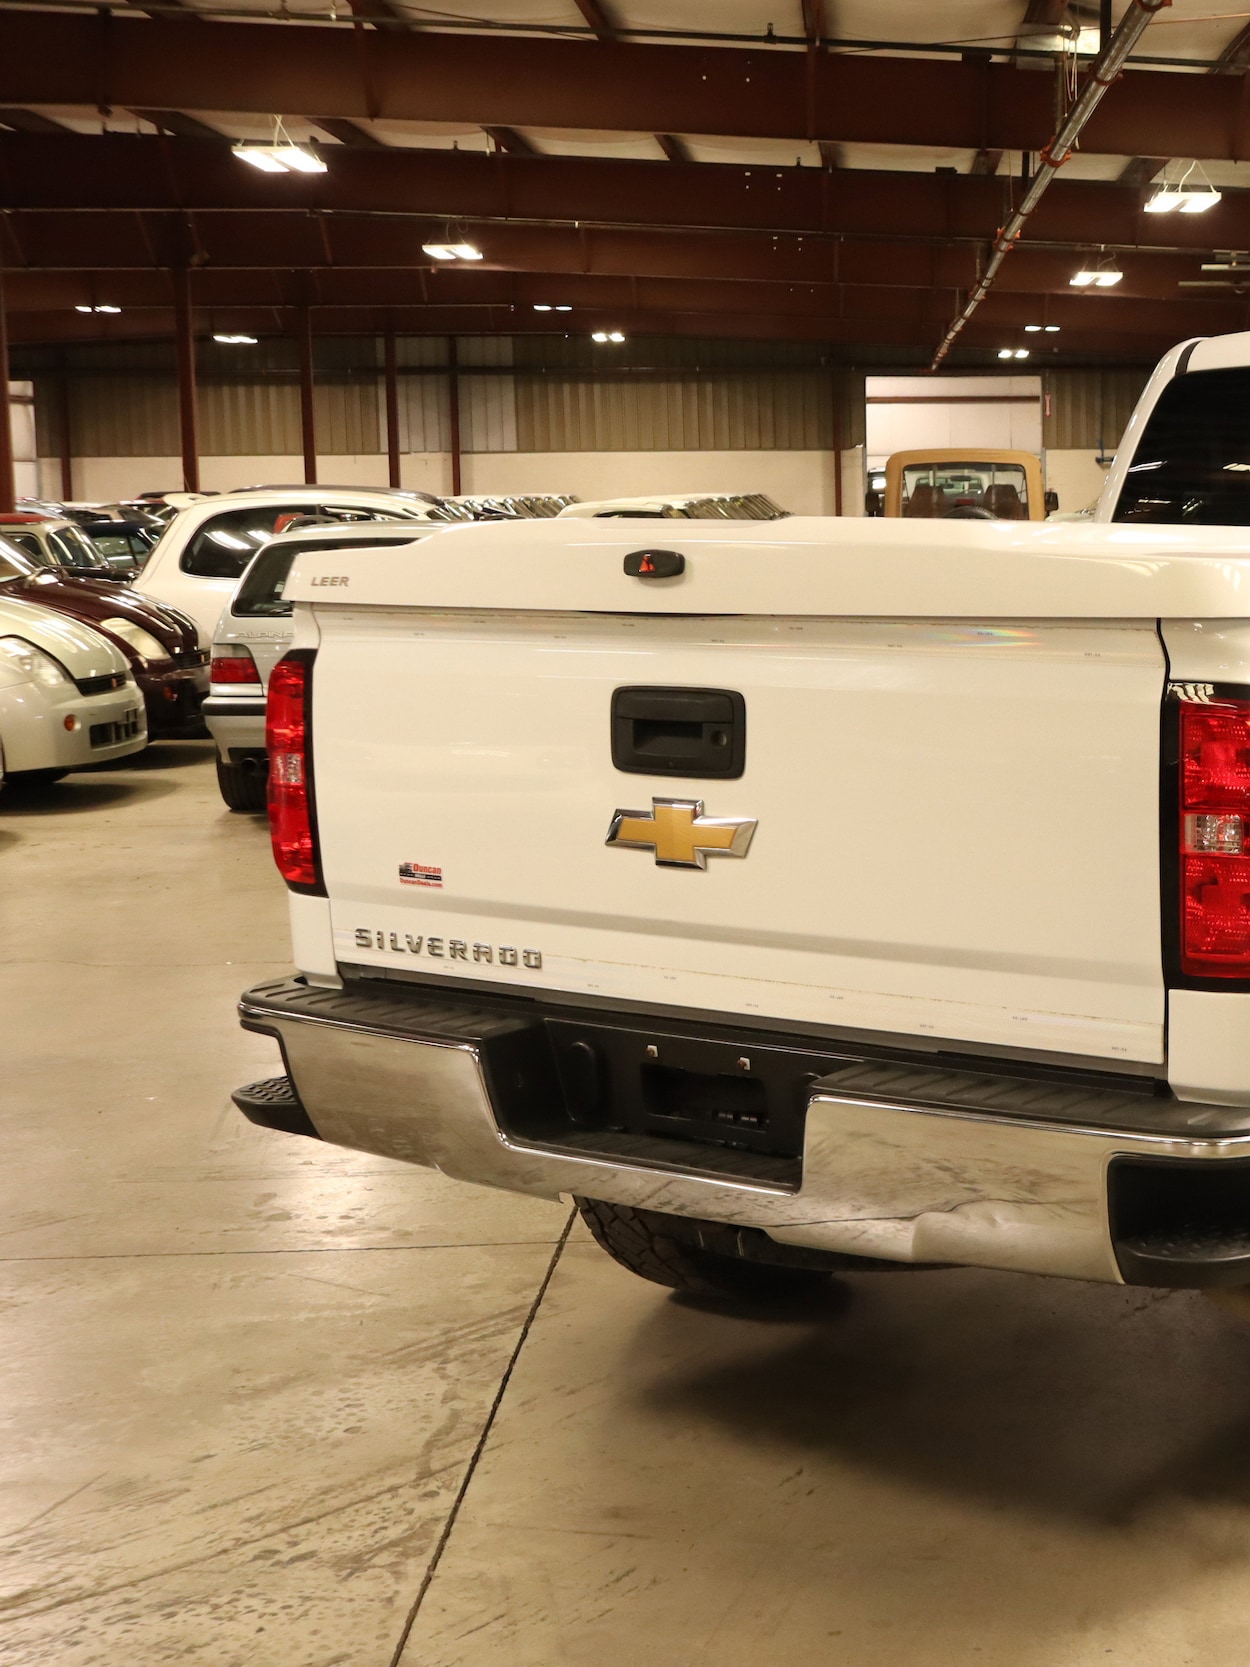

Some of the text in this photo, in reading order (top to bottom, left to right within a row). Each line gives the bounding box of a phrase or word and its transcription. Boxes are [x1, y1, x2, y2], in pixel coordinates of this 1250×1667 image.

[311, 576, 349, 587] LEER
[413, 863, 442, 875] Duncan
[354, 927, 542, 969] SILVERADO
